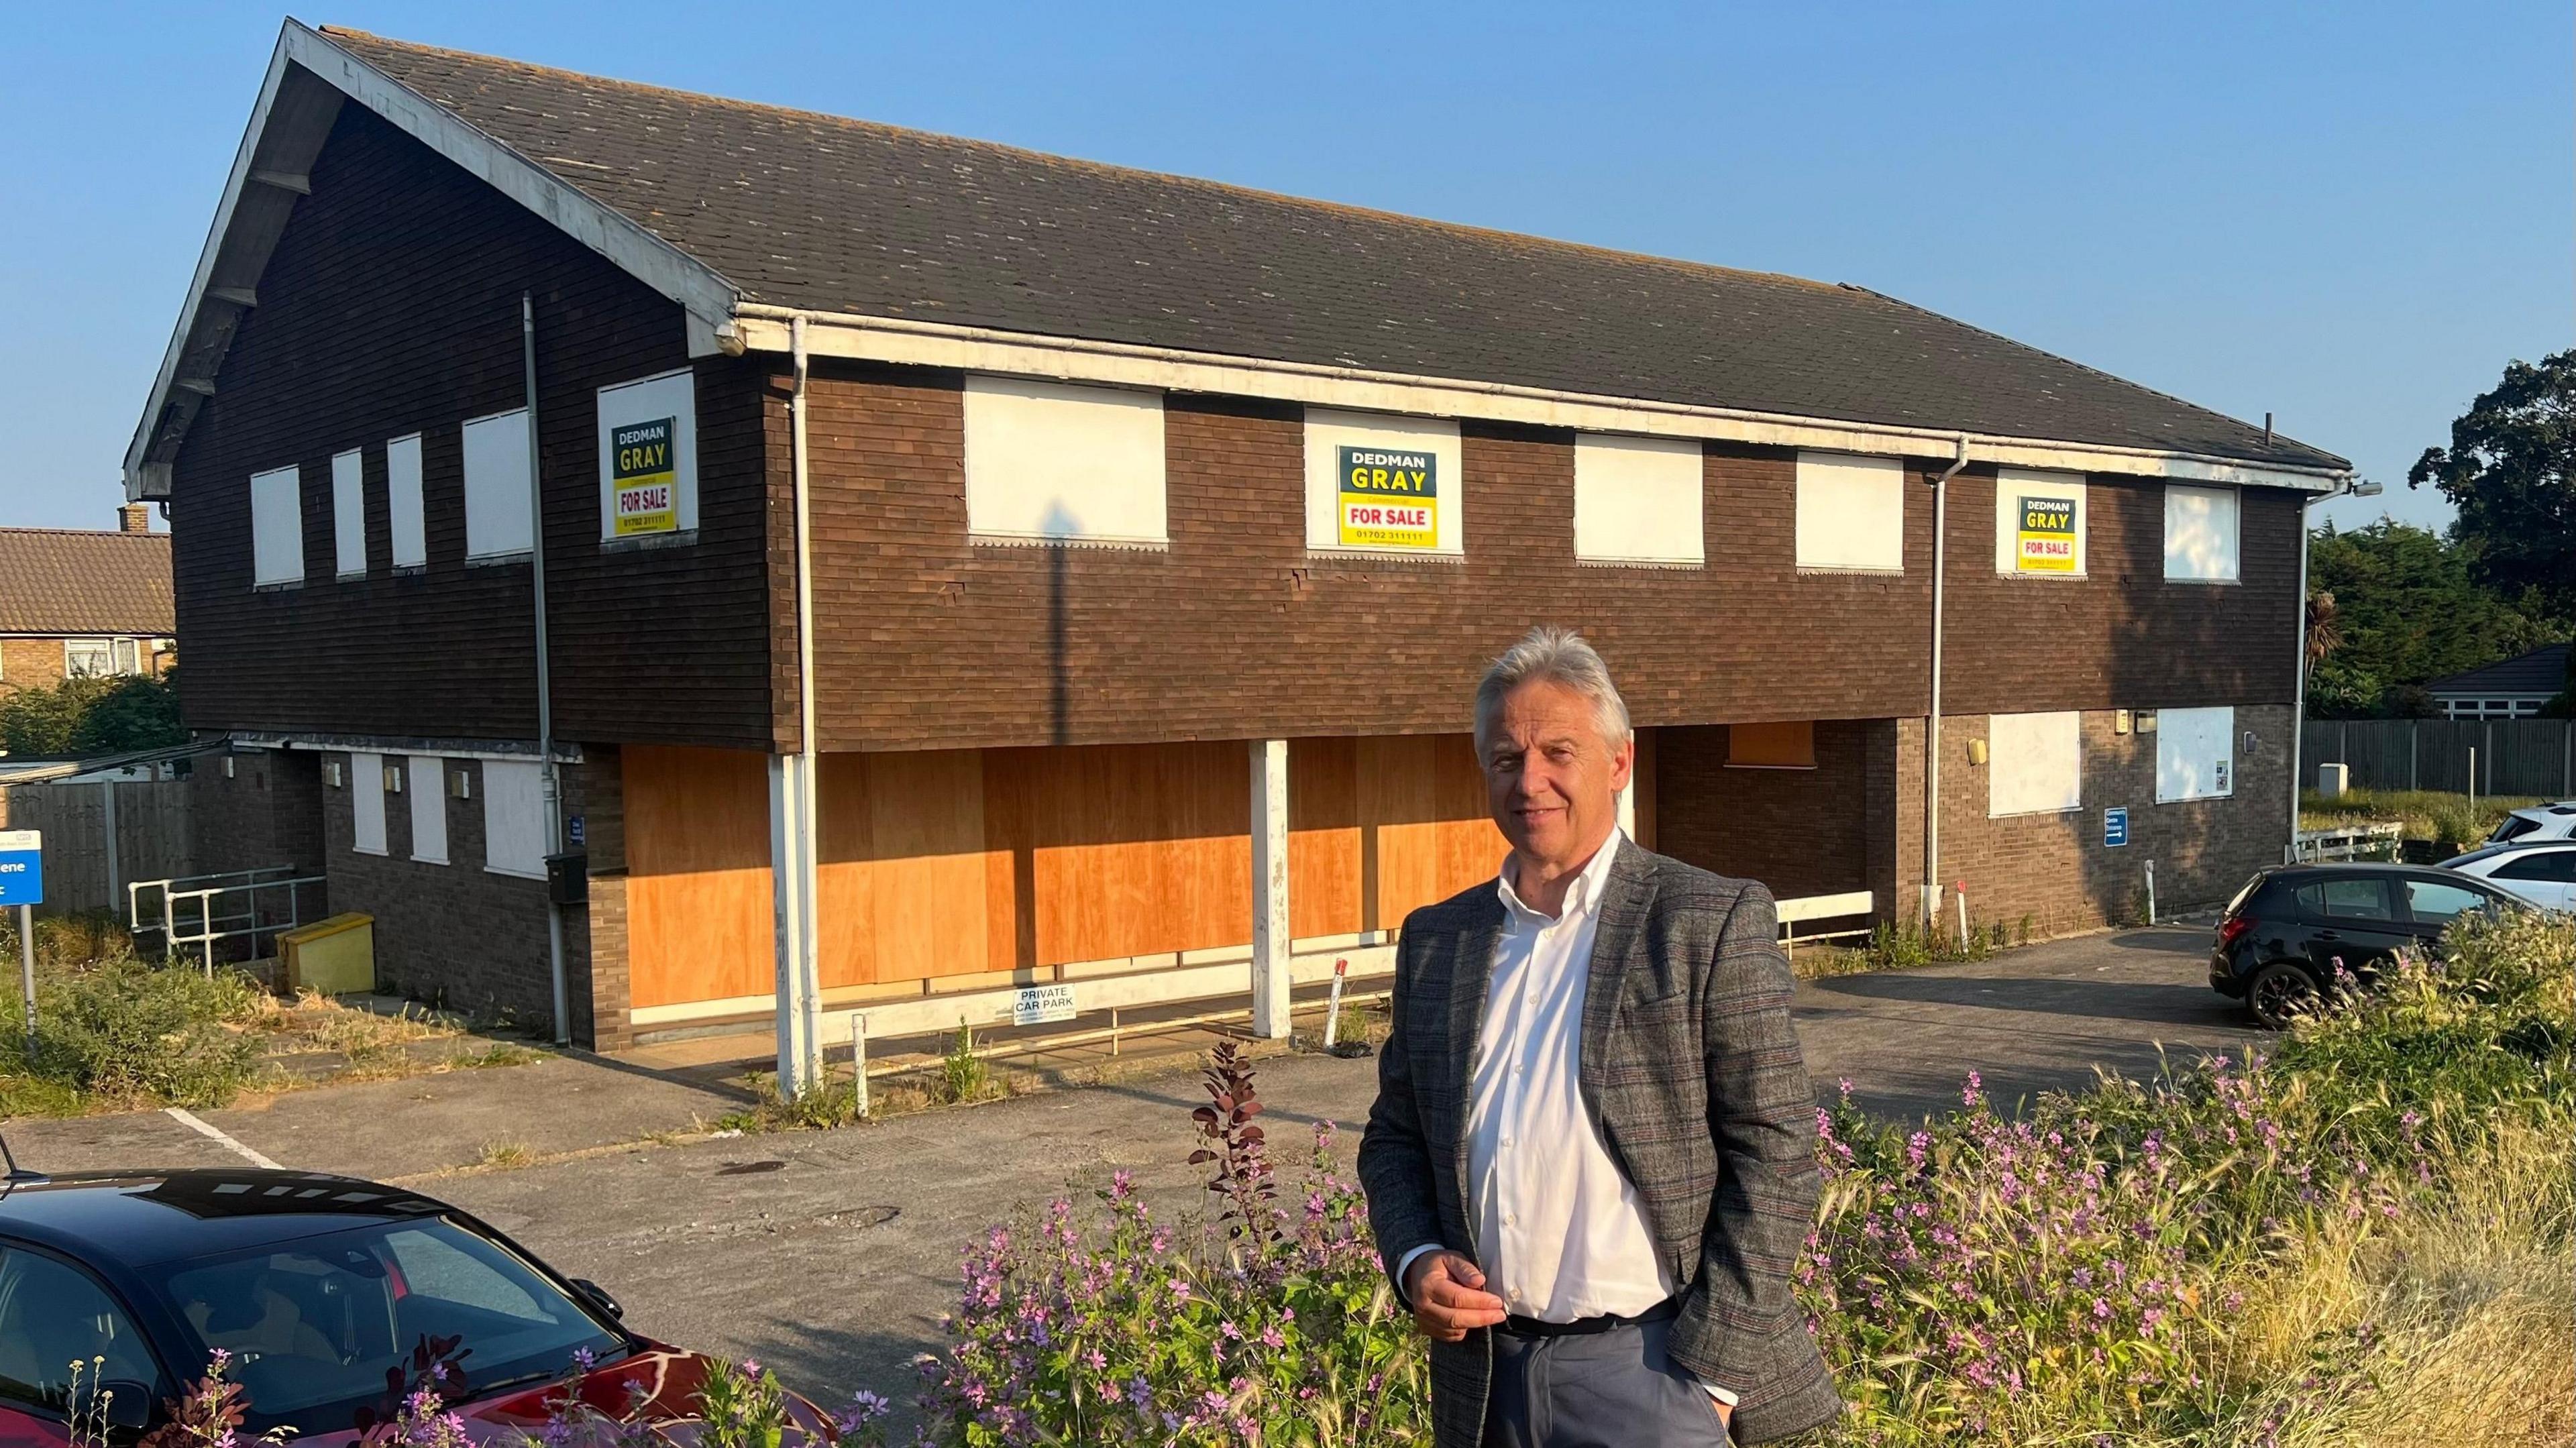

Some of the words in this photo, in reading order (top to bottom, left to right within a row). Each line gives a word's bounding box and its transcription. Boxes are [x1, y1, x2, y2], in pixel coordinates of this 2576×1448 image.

[619, 426, 664, 445] DEDMAN
[620, 443, 665, 471] GRAY
[1352, 452, 1425, 468] DEDMAN
[1351, 467, 1426, 491] GRAY
[621, 492, 640, 512] FOR
[643, 488, 667, 510] SALE
[2027, 500, 2070, 512] DEDMAN
[1351, 508, 1381, 524] FOR
[1386, 510, 1426, 525] SALE
[2027, 512, 2069, 528] GRAY
[1356, 531, 1385, 539] 01702
[1389, 532, 1422, 540] 311111
[2026, 542, 2043, 553] FOR
[2046, 543, 2068, 554] SALE
[1022, 987, 1067, 1000] PRIVATE
[1016, 1001, 1040, 1011] CAR
[1043, 997, 1073, 1008] PARK
